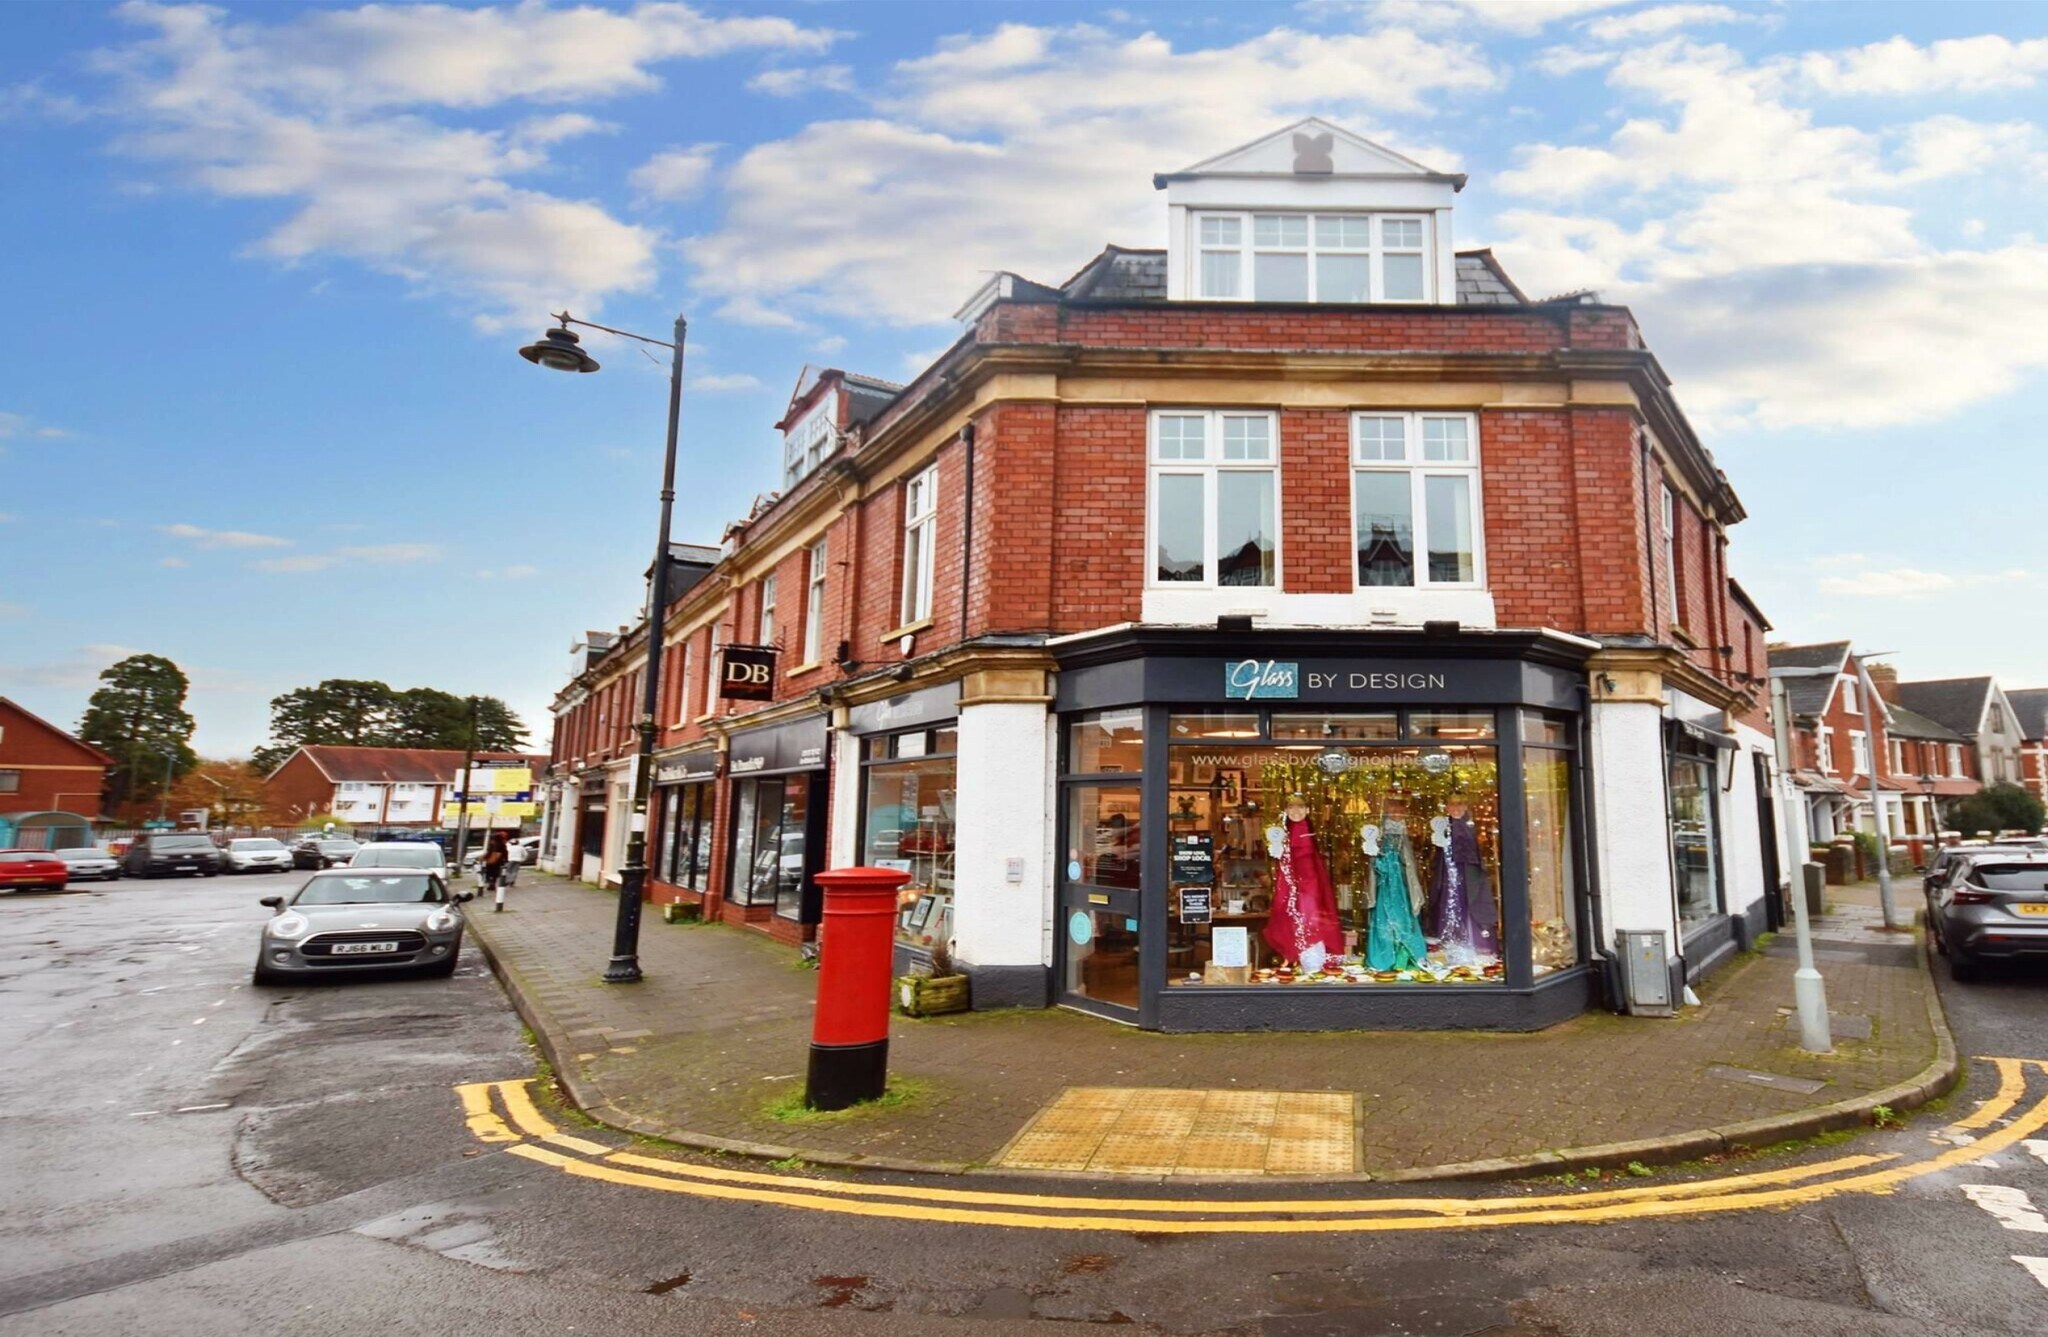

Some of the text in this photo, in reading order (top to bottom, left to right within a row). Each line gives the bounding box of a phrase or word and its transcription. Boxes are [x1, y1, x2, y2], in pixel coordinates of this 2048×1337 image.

[726, 661, 770, 684] DB
[1231, 659, 1445, 701] Glass BY DESIGN
[1192, 752, 1474, 769] www.glassbydignonlineo.uk
